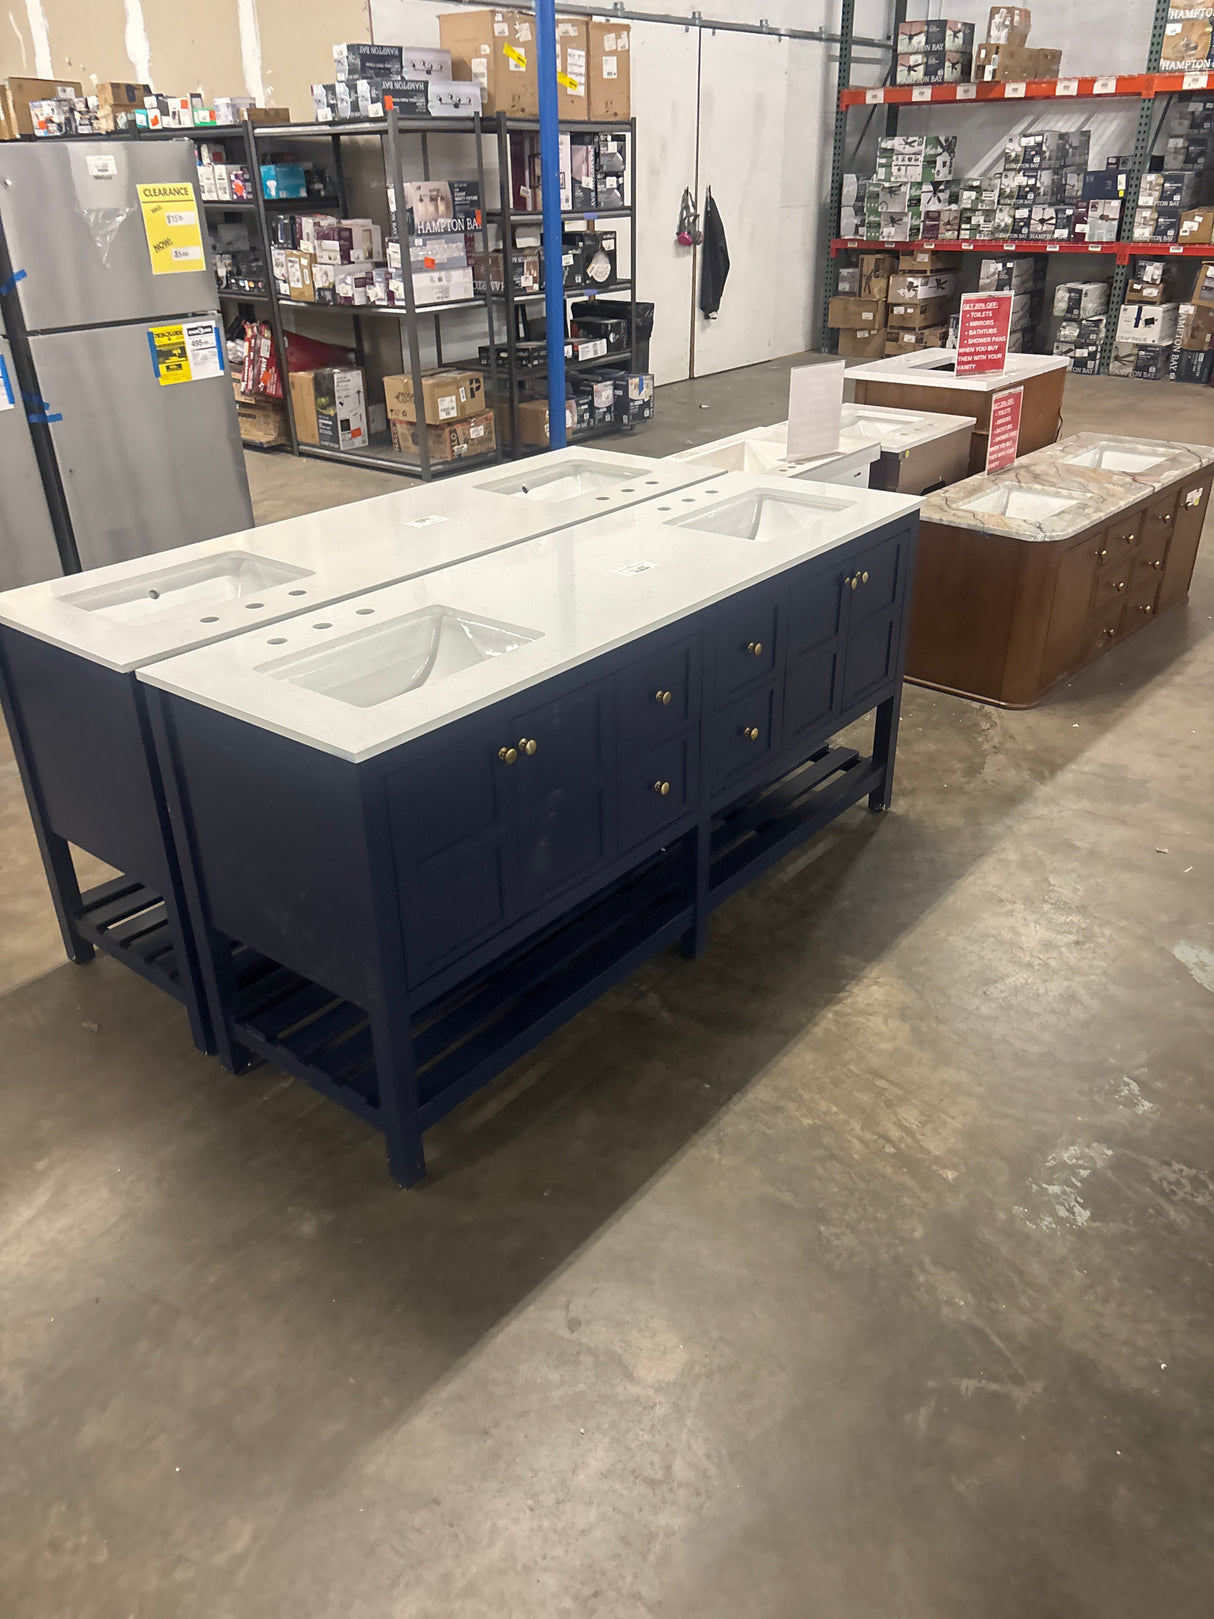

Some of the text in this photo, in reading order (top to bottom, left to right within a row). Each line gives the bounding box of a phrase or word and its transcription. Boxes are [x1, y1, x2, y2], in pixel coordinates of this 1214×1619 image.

[1170, 8, 1214, 19] HAMPTO
[370, 46, 399, 56] HAMPTON
[931, 43, 944, 51] BAY
[1161, 59, 1211, 70] HAMPTON
[931, 74, 943, 82] BAY
[382, 81, 424, 90] HAMPTON BAY
[143, 187, 189, 197] CLEARANCE
[417, 218, 482, 234] HAMPTON BA
[1169, 313, 1187, 371] AMPTON BAY
[1143, 371, 1155, 379] BAY
